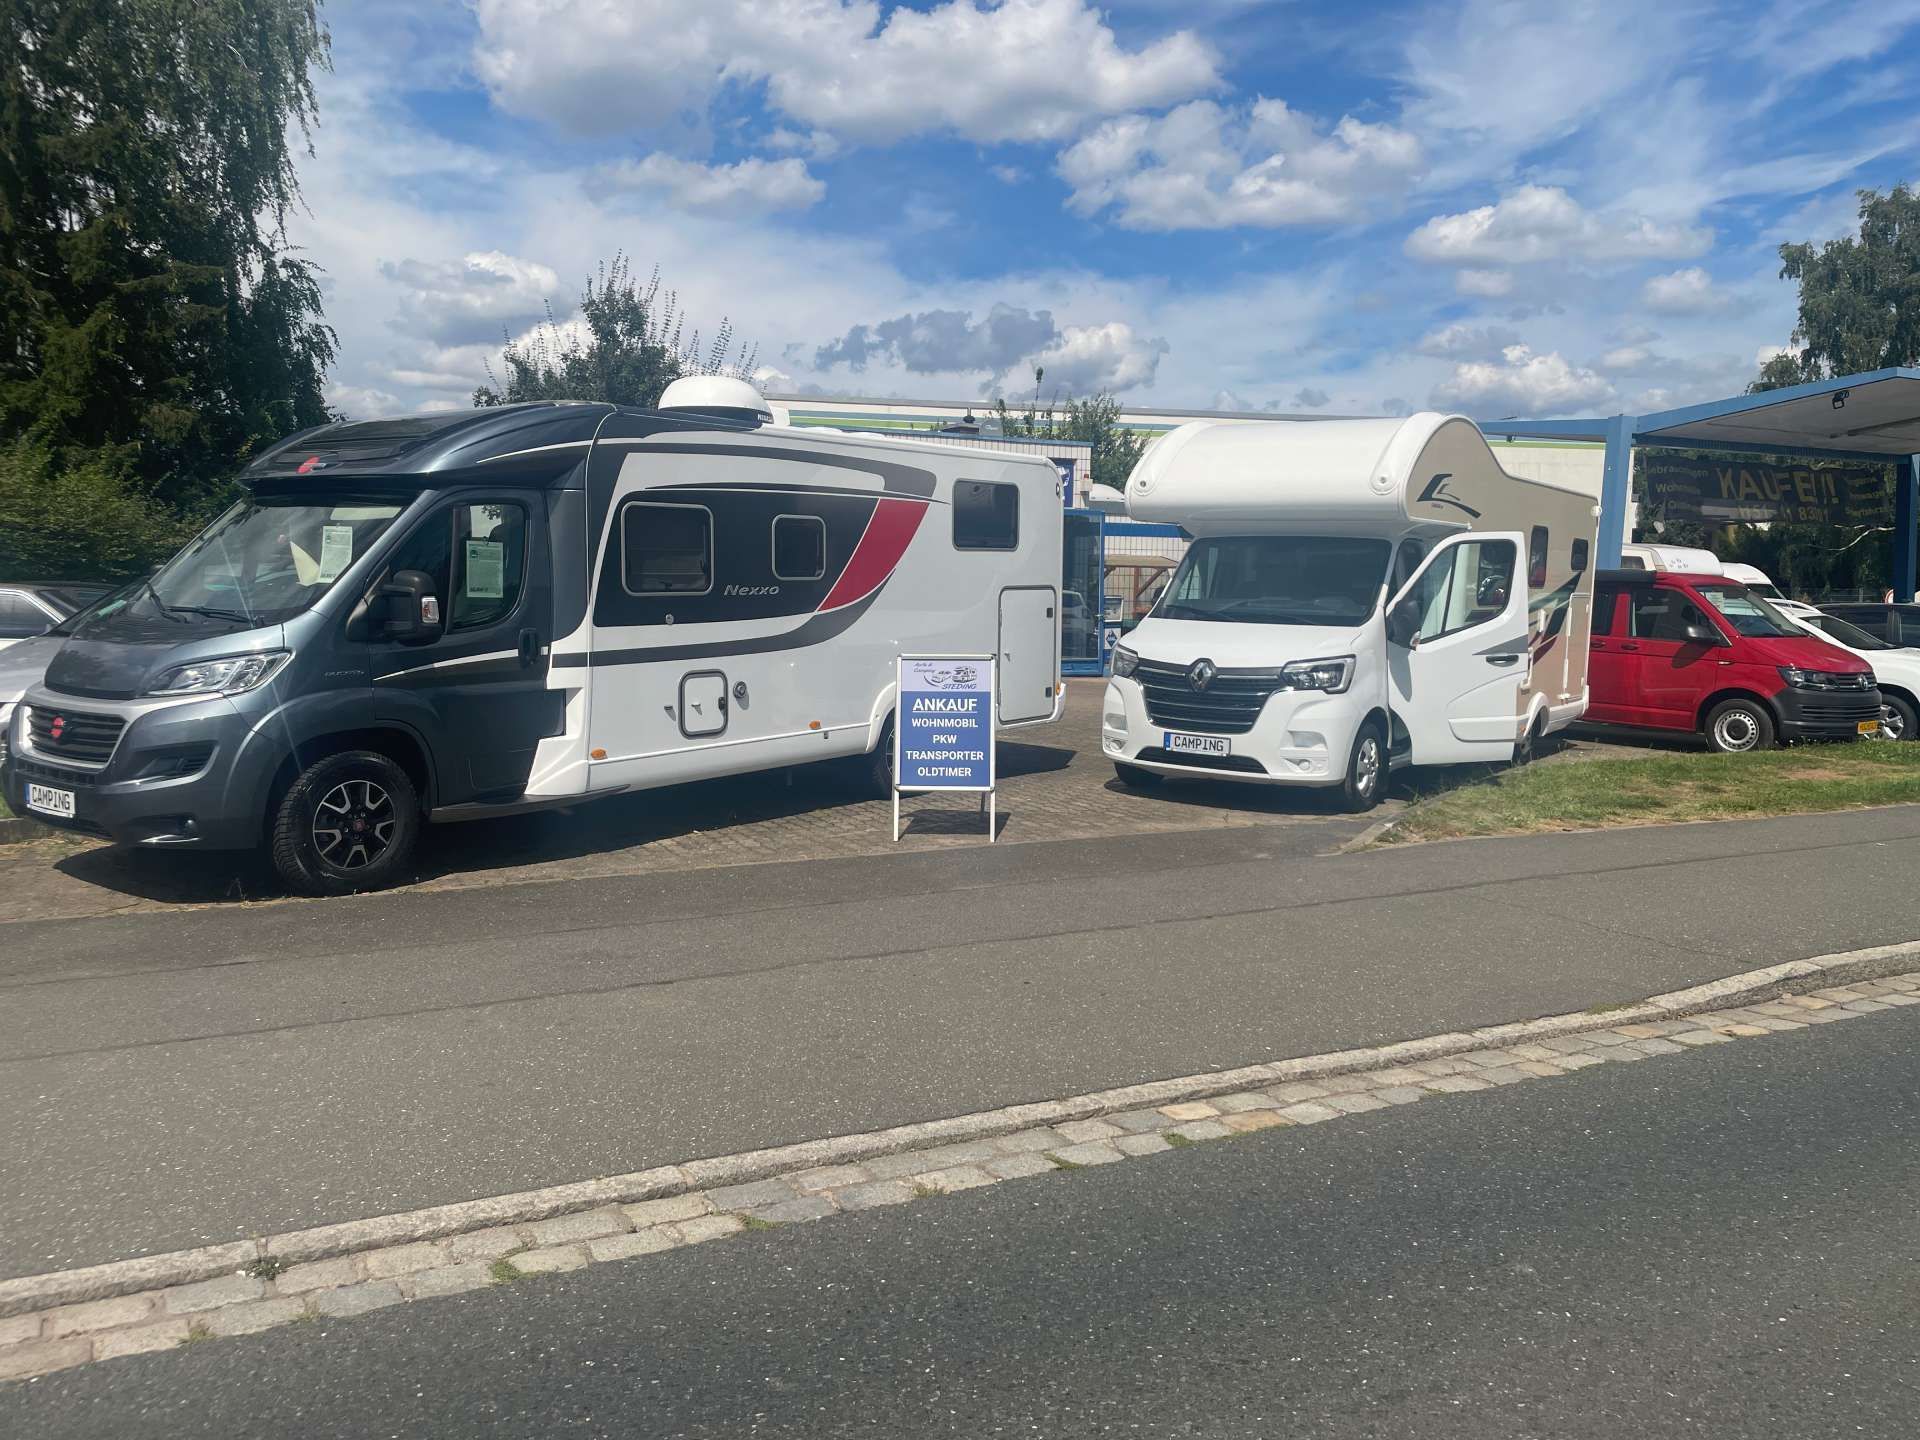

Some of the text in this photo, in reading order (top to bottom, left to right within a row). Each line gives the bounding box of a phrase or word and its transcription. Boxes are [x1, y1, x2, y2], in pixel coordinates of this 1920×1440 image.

[723, 584, 780, 596] Nexxo
[912, 698, 978, 712] ANKAUF
[911, 718, 978, 728] WOHNMOBIL
[932, 734, 958, 744] PKW
[1174, 736, 1224, 751] CAMPING
[905, 750, 984, 761] TRANSPORTER
[917, 766, 972, 777] OLDTIMER
[32, 786, 70, 810] CAMPING
